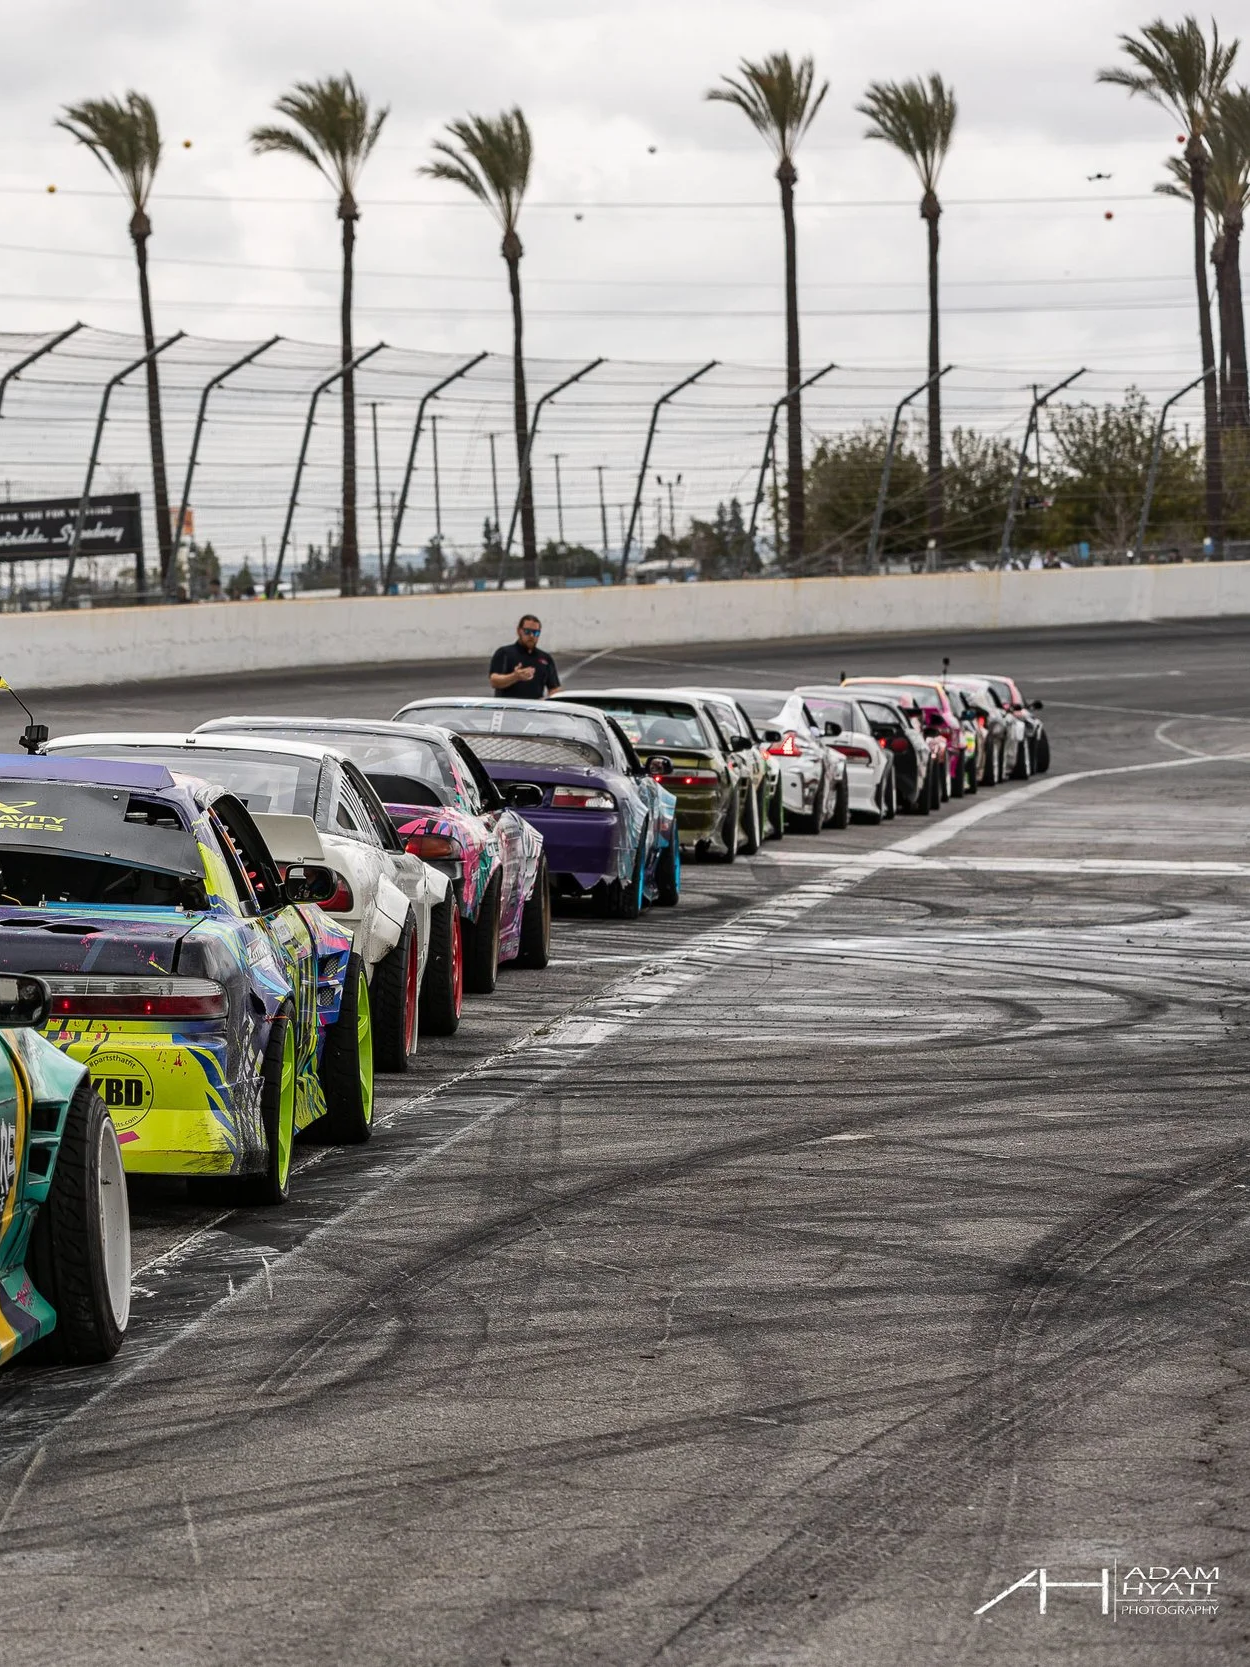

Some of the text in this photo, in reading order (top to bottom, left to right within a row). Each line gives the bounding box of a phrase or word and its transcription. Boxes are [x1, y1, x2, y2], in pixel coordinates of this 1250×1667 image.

[45, 509, 66, 519] FOR
[68, 506, 113, 517] VIITING
[89, 1055, 136, 1069] #partsthatfit
